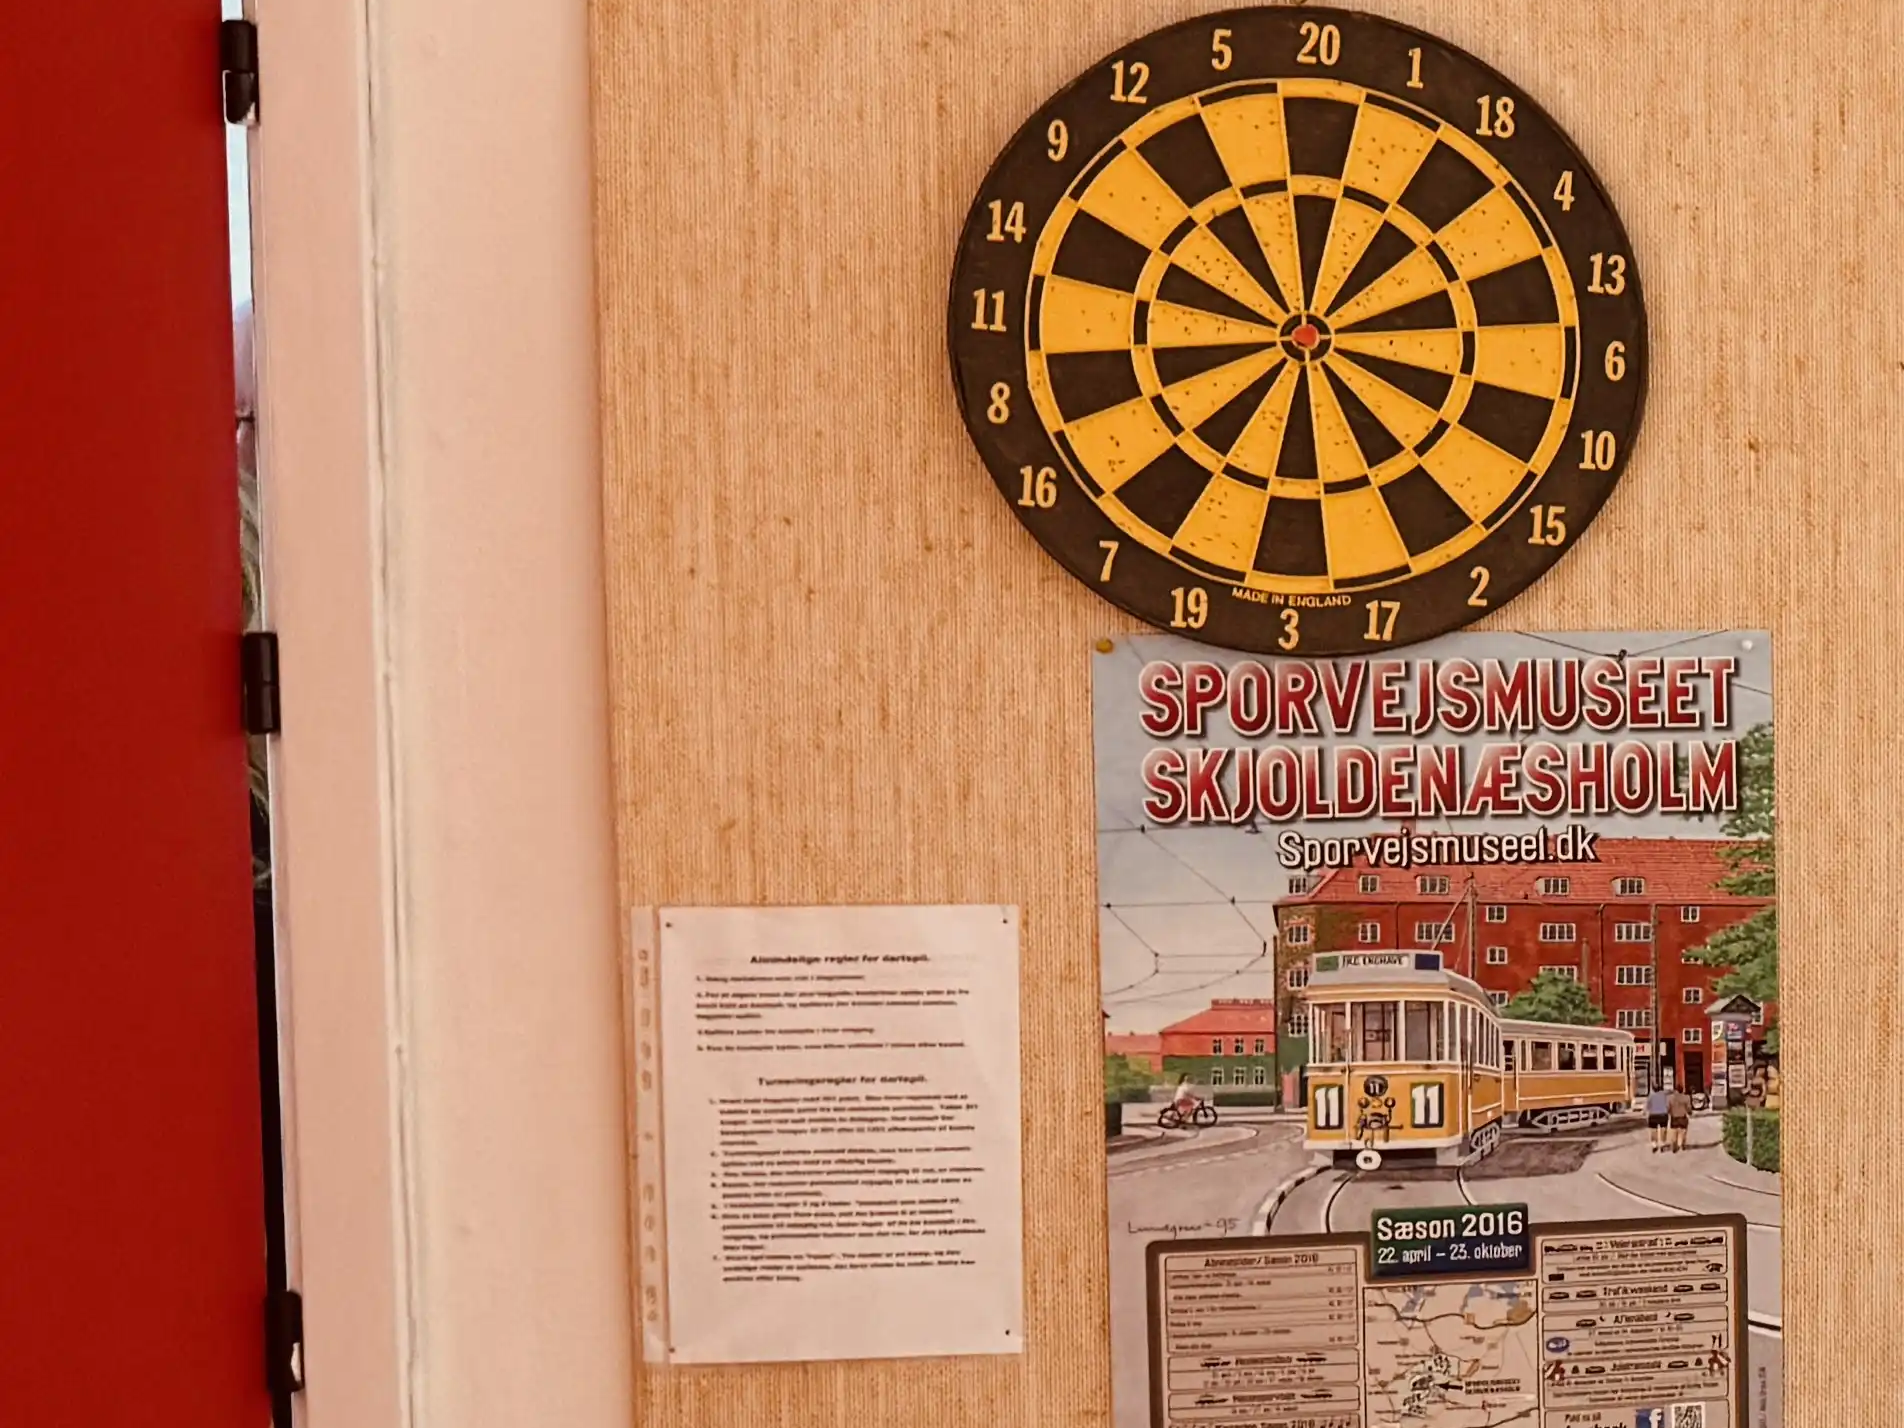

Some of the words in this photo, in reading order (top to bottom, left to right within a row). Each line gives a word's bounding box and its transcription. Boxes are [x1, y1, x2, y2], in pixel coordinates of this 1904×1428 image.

[1212, 30, 1232, 70] 5
[1299, 22, 1341, 66] 20
[1110, 63, 1150, 103] 12
[1408, 49, 1424, 88] 1
[1476, 97, 1516, 138] 18
[1048, 120, 1068, 161] 9
[1552, 171, 1575, 210] 4
[987, 201, 1027, 241] 14
[1588, 254, 1626, 294] 13
[971, 290, 1007, 331] 11
[1605, 340, 1626, 380] 6
[988, 383, 1010, 423] 8
[1579, 431, 1616, 471] 10
[1018, 468, 1058, 508] 16
[1528, 506, 1566, 546] 15
[1099, 541, 1119, 581] 7
[1232, 587, 1268, 603] MADE
[1272, 594, 1284, 606] IN
[1288, 595, 1351, 607] ENGLAND
[1469, 567, 1489, 606] 2
[1170, 588, 1208, 628] 19
[1364, 601, 1401, 641] 17
[1278, 610, 1299, 650] 3
[1139, 657, 1735, 736] SPORVEJSMUSEET
[1141, 740, 1737, 824] SKJOLDENÆSHOLM
[1315, 1086, 1338, 1127] 11
[1412, 1085, 1439, 1125] 11
[1377, 1217, 1456, 1240] Sæson
[1463, 1210, 1523, 1237] 2016
[1378, 1246, 1399, 1263] 22.
[1402, 1244, 1431, 1264] april
[1450, 1244, 1470, 1259] 23.
[1474, 1242, 1523, 1259] oktober
